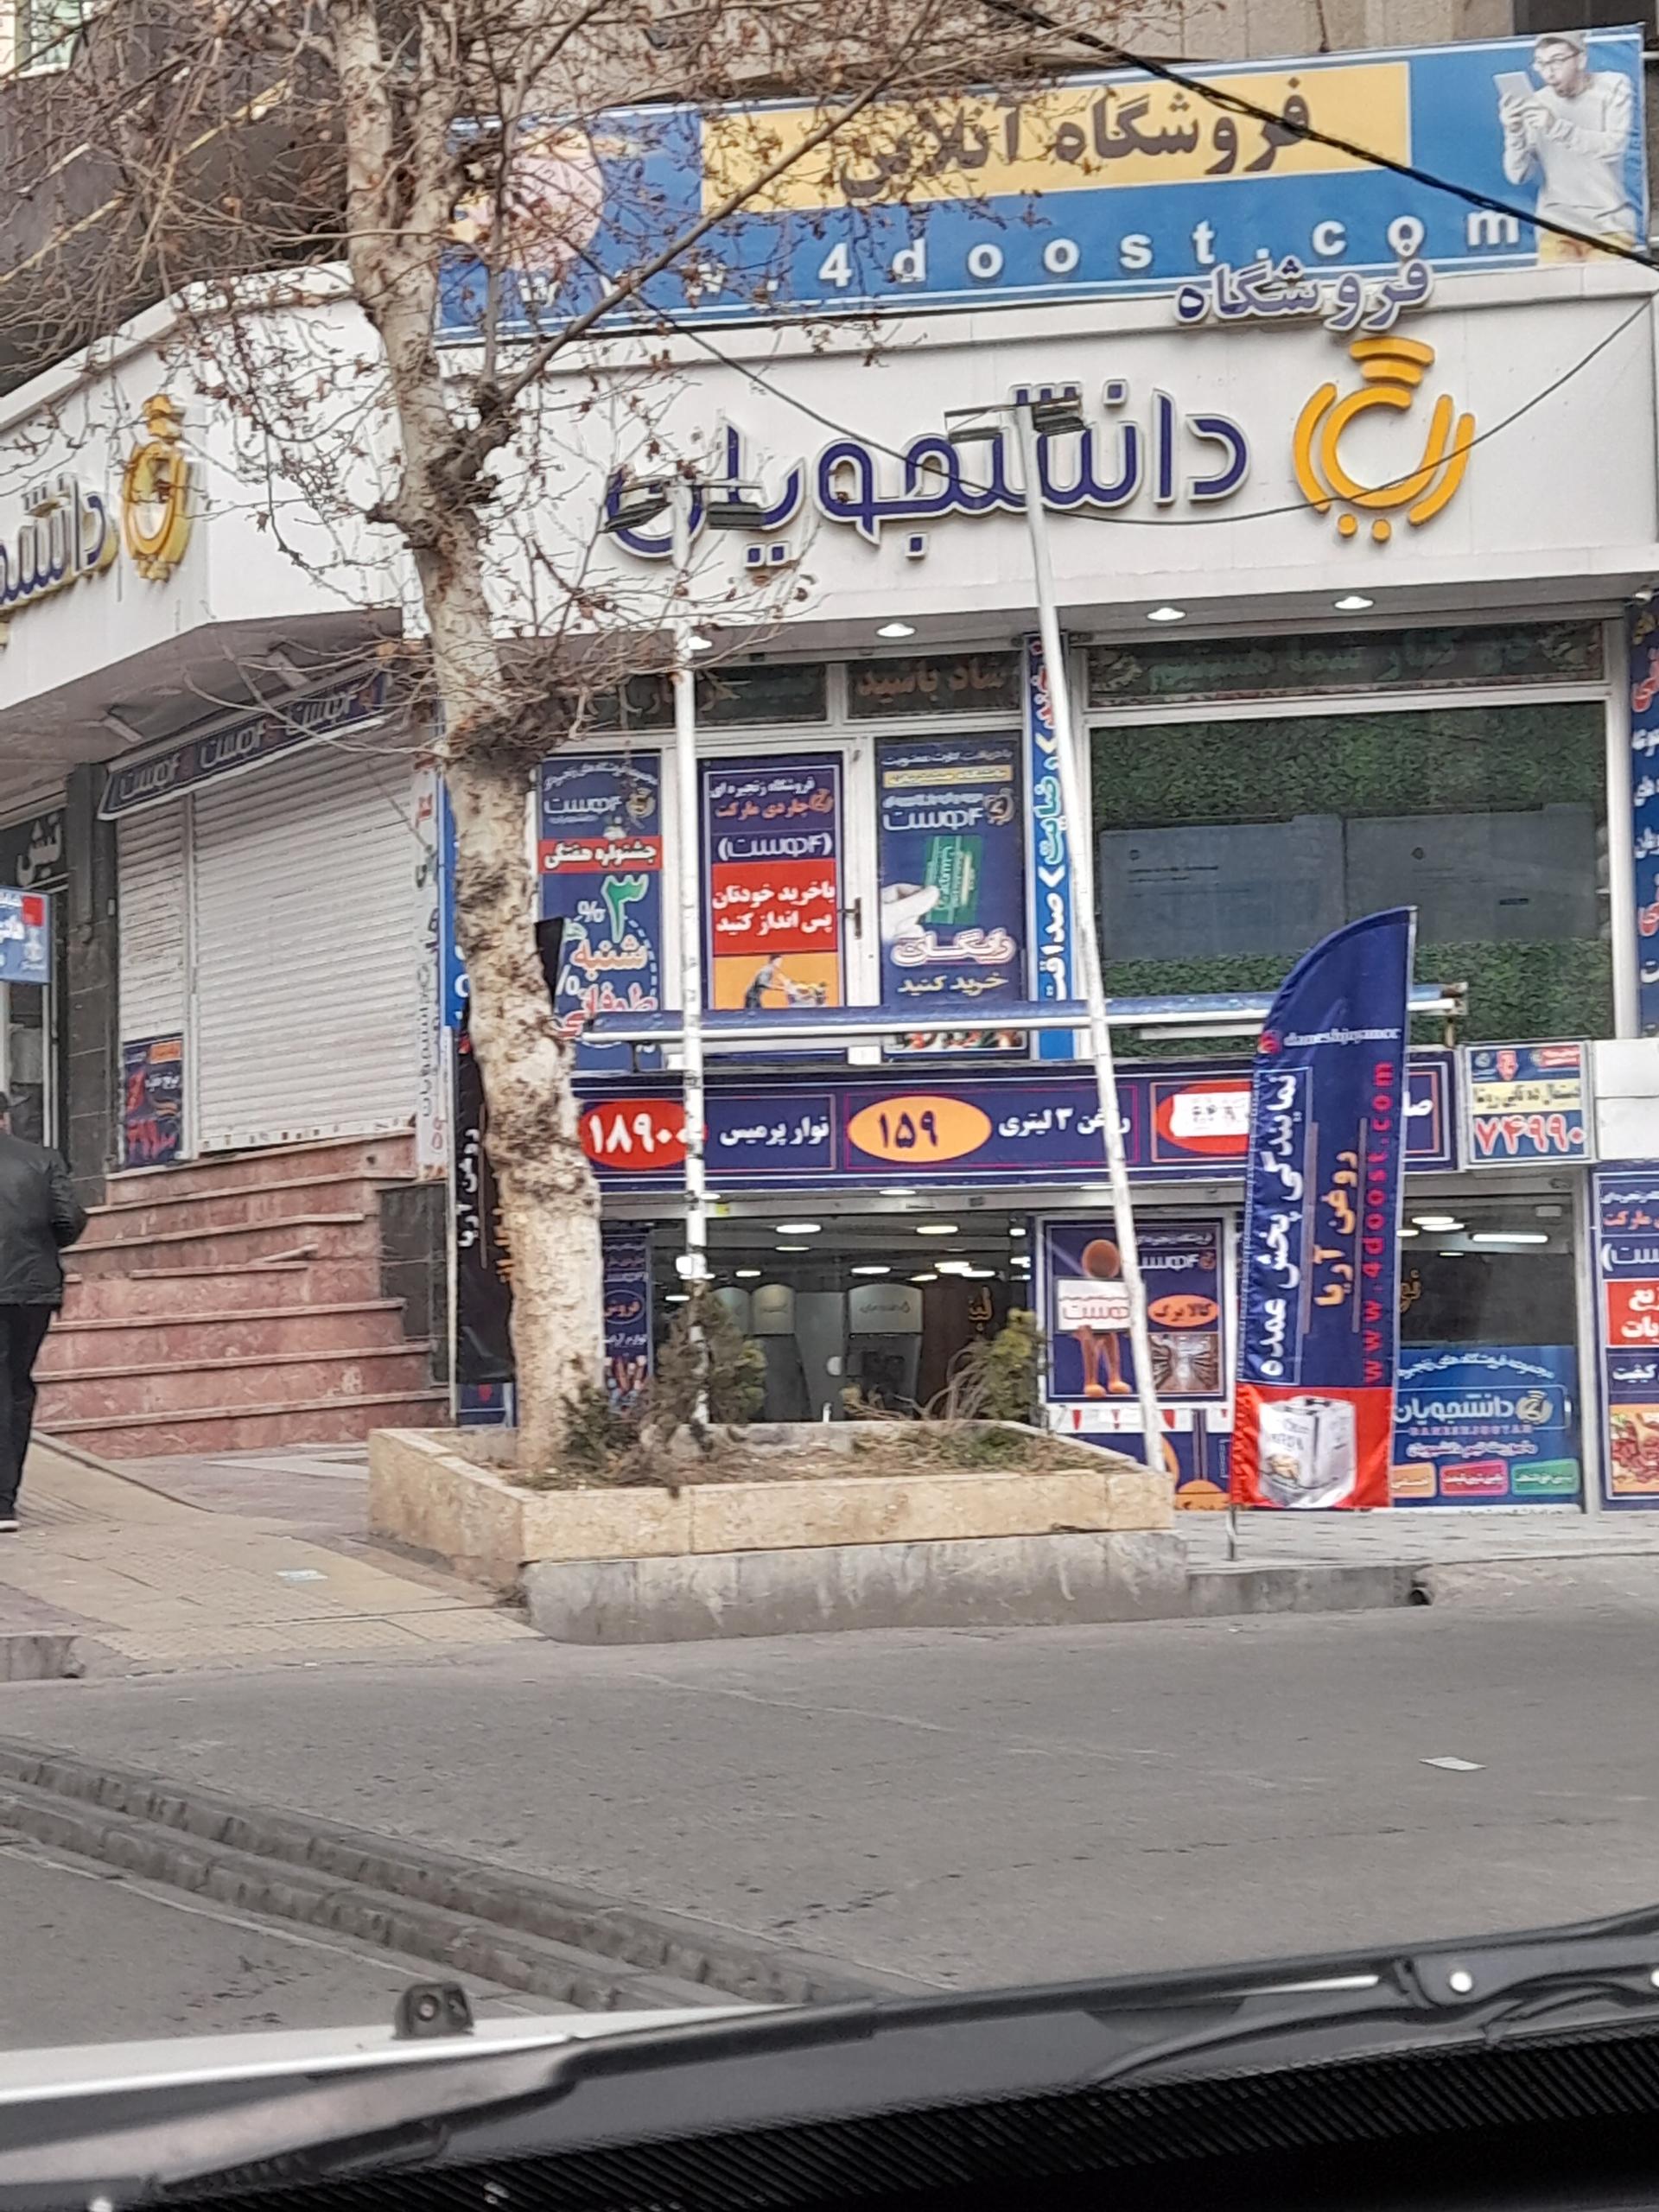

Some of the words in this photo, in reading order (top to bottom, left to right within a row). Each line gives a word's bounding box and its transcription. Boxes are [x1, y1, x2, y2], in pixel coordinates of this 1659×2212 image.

[1054, 77, 1313, 174] فروشگاه
[1176, 239, 1435, 334] فروشگاه
[605, 378, 1251, 569] دانشجویان
[711, 882, 775, 910] خودتان
[715, 912, 754, 936] کنید
[756, 909, 800, 937] انداز
[569, 934, 647, 982] شنبه
[1039, 892, 1066, 1001] صداقت
[896, 974, 948, 996] کنید
[950, 971, 1009, 997] خرید
[877, 1110, 938, 1149] ۱۵۹
[997, 1109, 1052, 1137] لیتری
[1260, 1074, 1303, 1202] نمایندگی
[1474, 1113, 1587, 1157] ۷۴۹۹۰
[1319, 1151, 1358, 1236] روغن
[1255, 1210, 1303, 1290] پخش
[1258, 1298, 1287, 1376] عمده
[1394, 1392, 1514, 1425] دانشجویان
